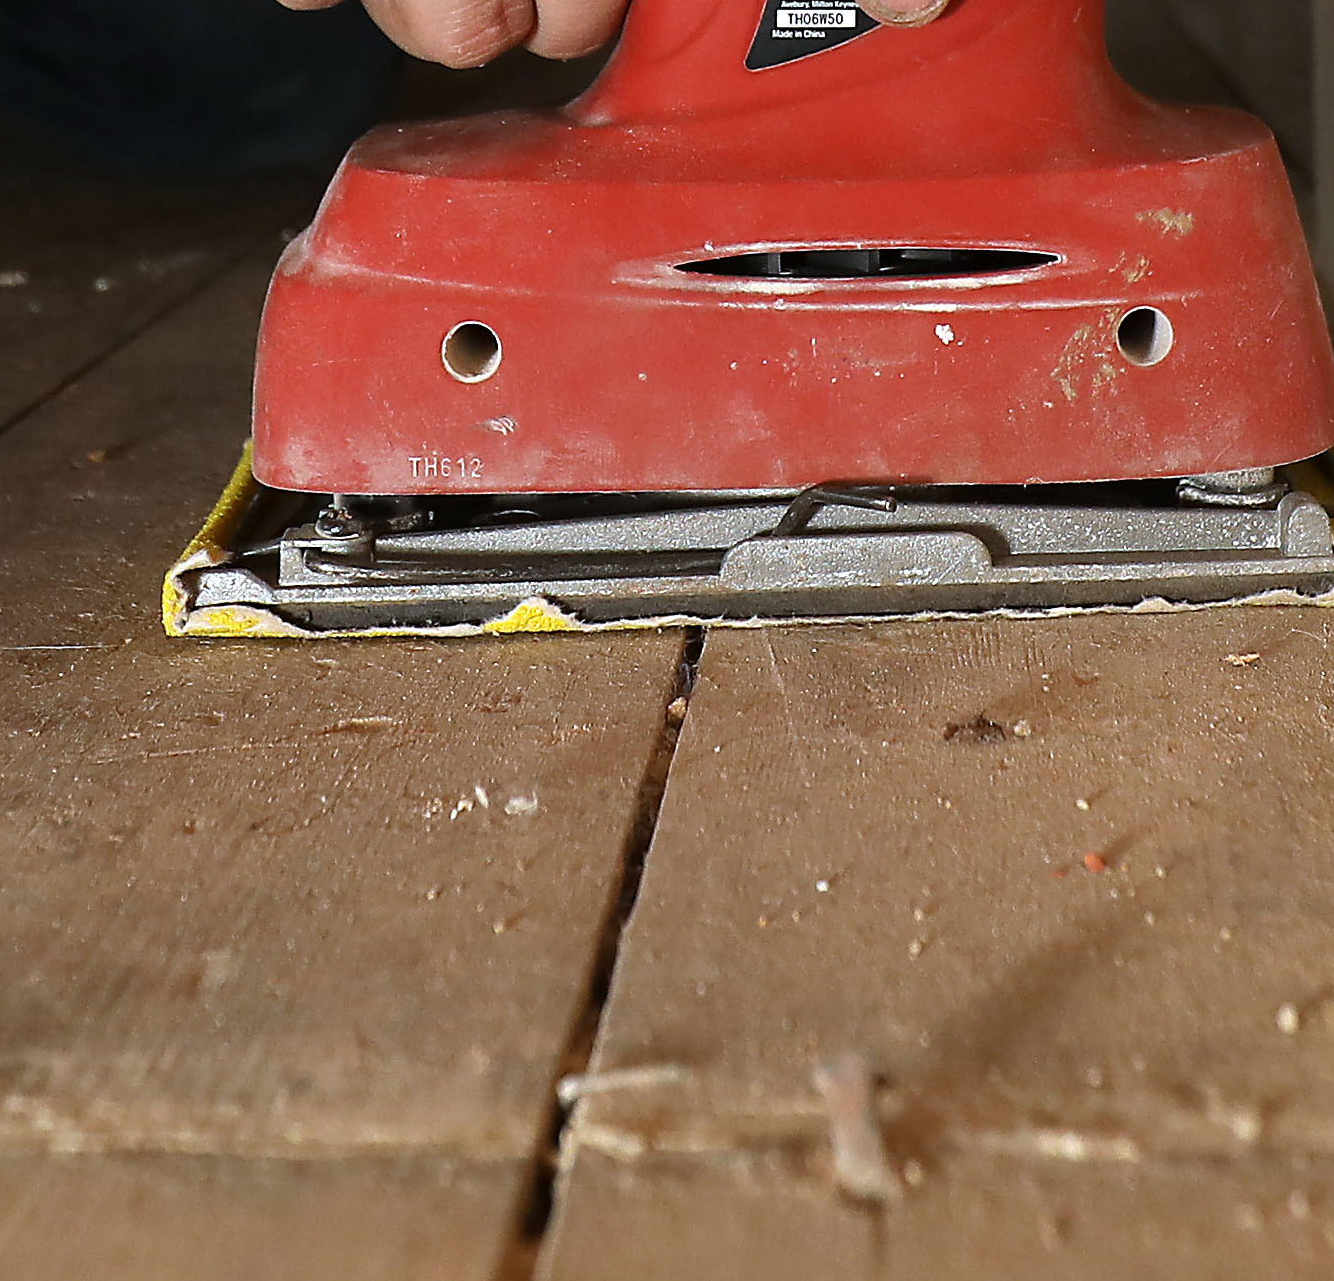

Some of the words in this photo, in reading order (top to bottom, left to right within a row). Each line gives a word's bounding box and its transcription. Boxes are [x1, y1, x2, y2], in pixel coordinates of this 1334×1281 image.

[811, 0, 834, 8] Milton
[771, 30, 793, 38] Made
[794, 30, 803, 38] in
[803, 30, 826, 39] China
